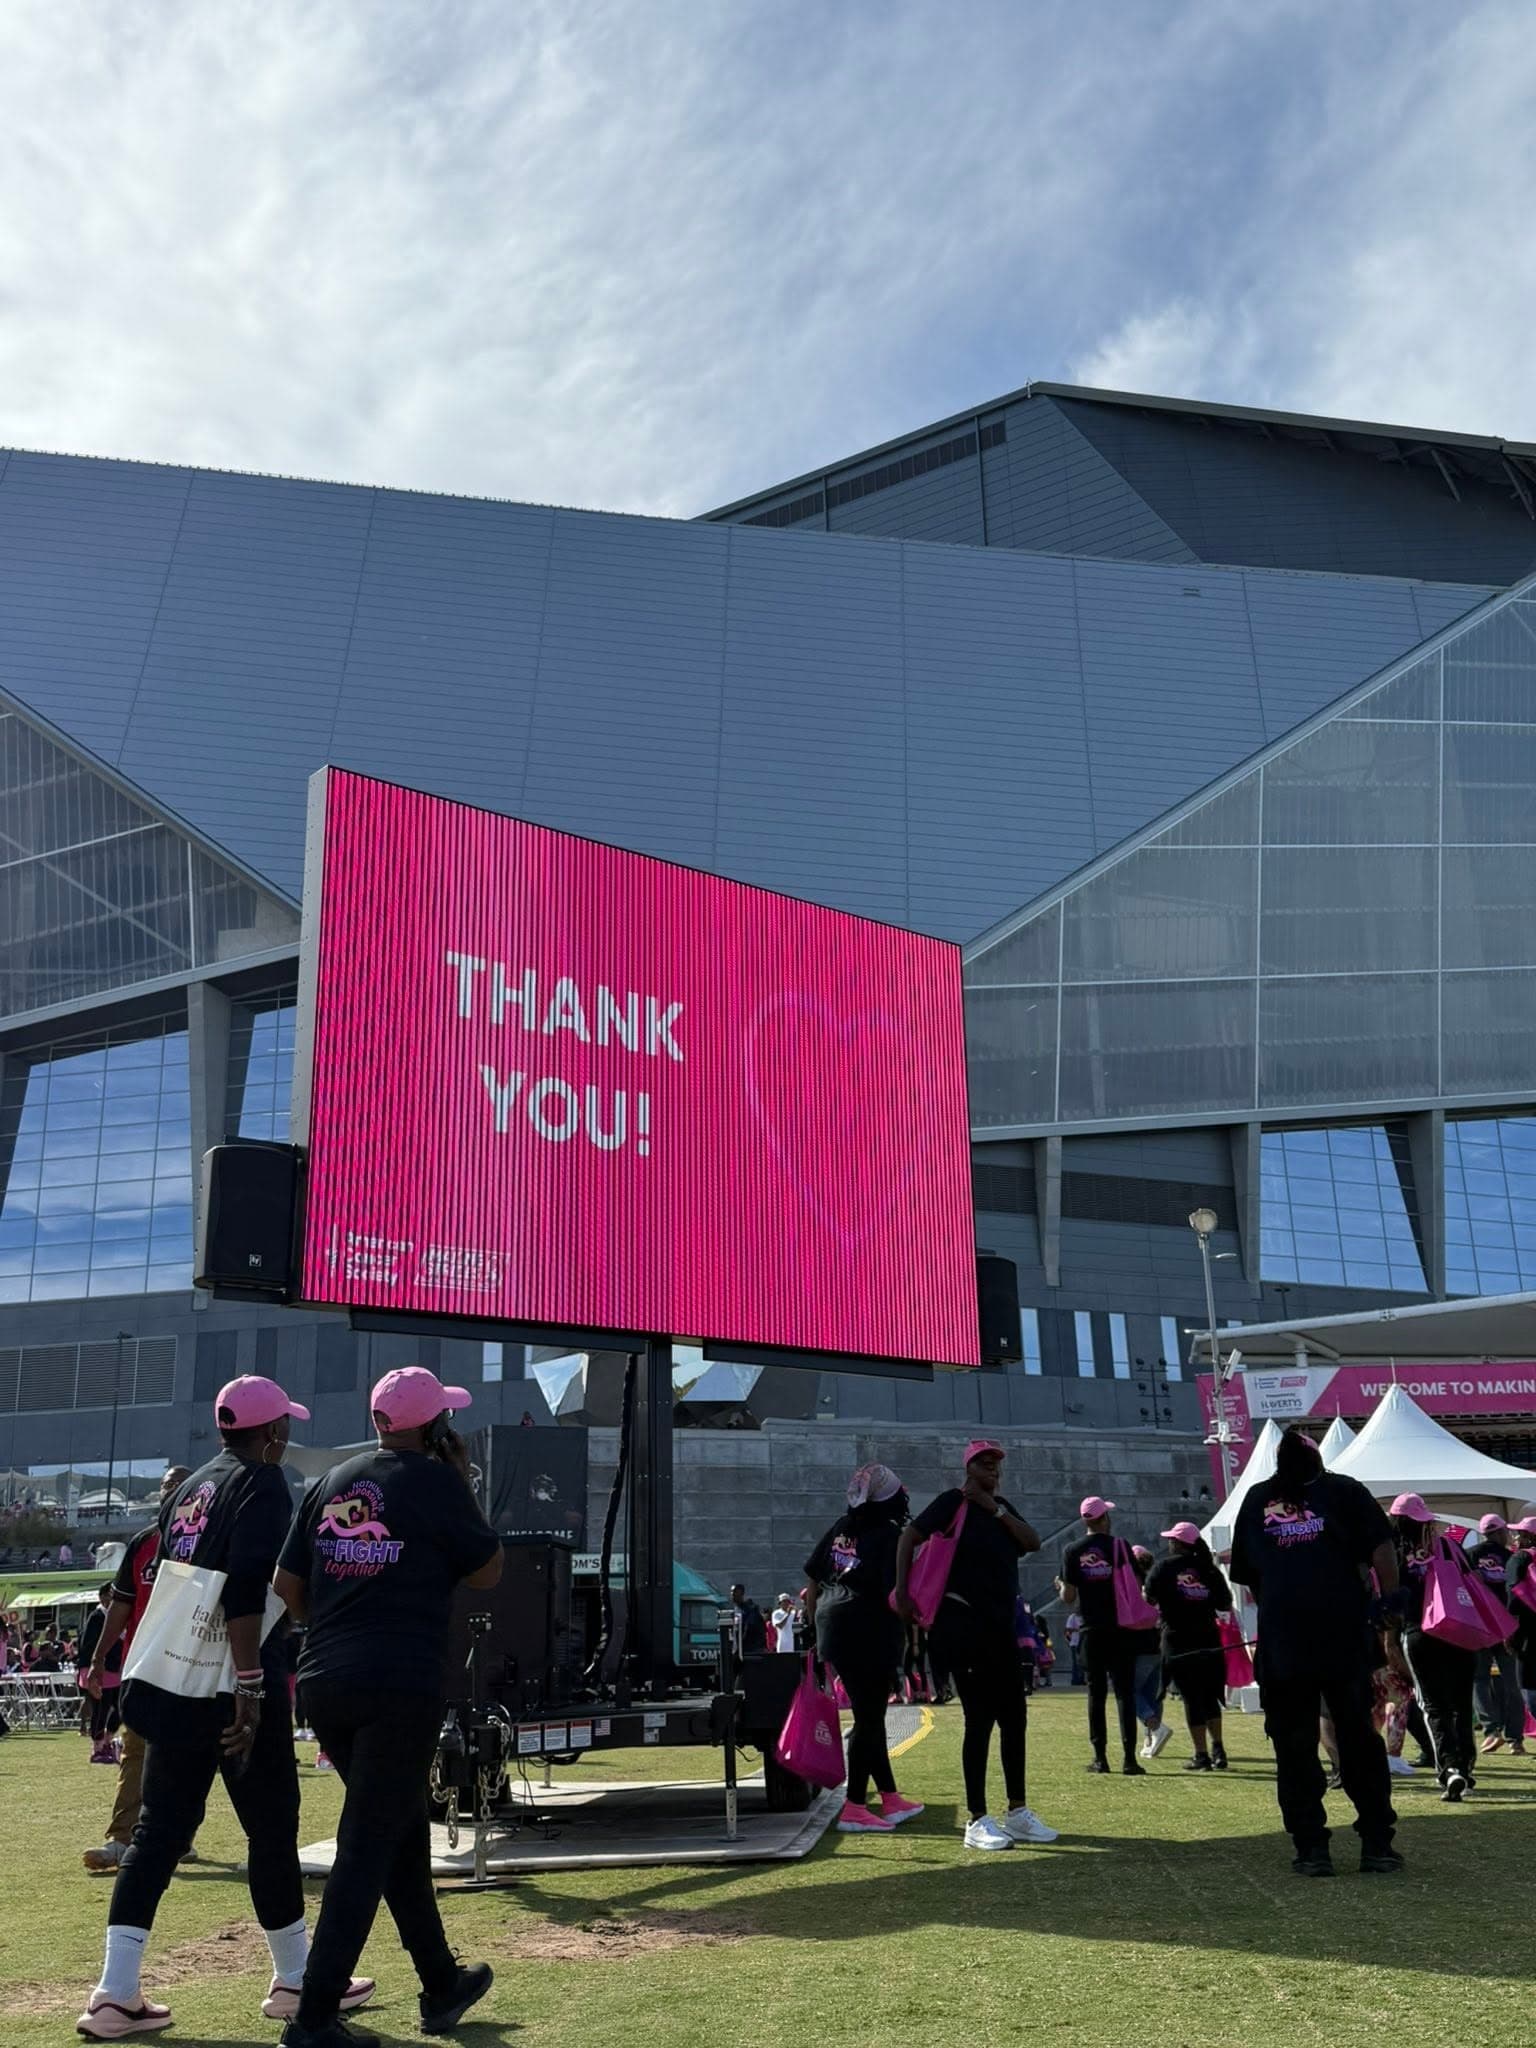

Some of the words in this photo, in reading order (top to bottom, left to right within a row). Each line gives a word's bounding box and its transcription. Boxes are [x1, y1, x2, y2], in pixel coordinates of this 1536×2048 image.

[446, 950, 683, 1062] THANK
[479, 1063, 650, 1157] YOU!
[1360, 1382, 1447, 1397] WECOME
[1450, 1381, 1474, 1395] TO
[1478, 1379, 1536, 1395] MAKIN
[352, 1480, 384, 1500] NOTHING
[335, 1538, 404, 1563] FIGHT
[325, 1560, 385, 1582] together
